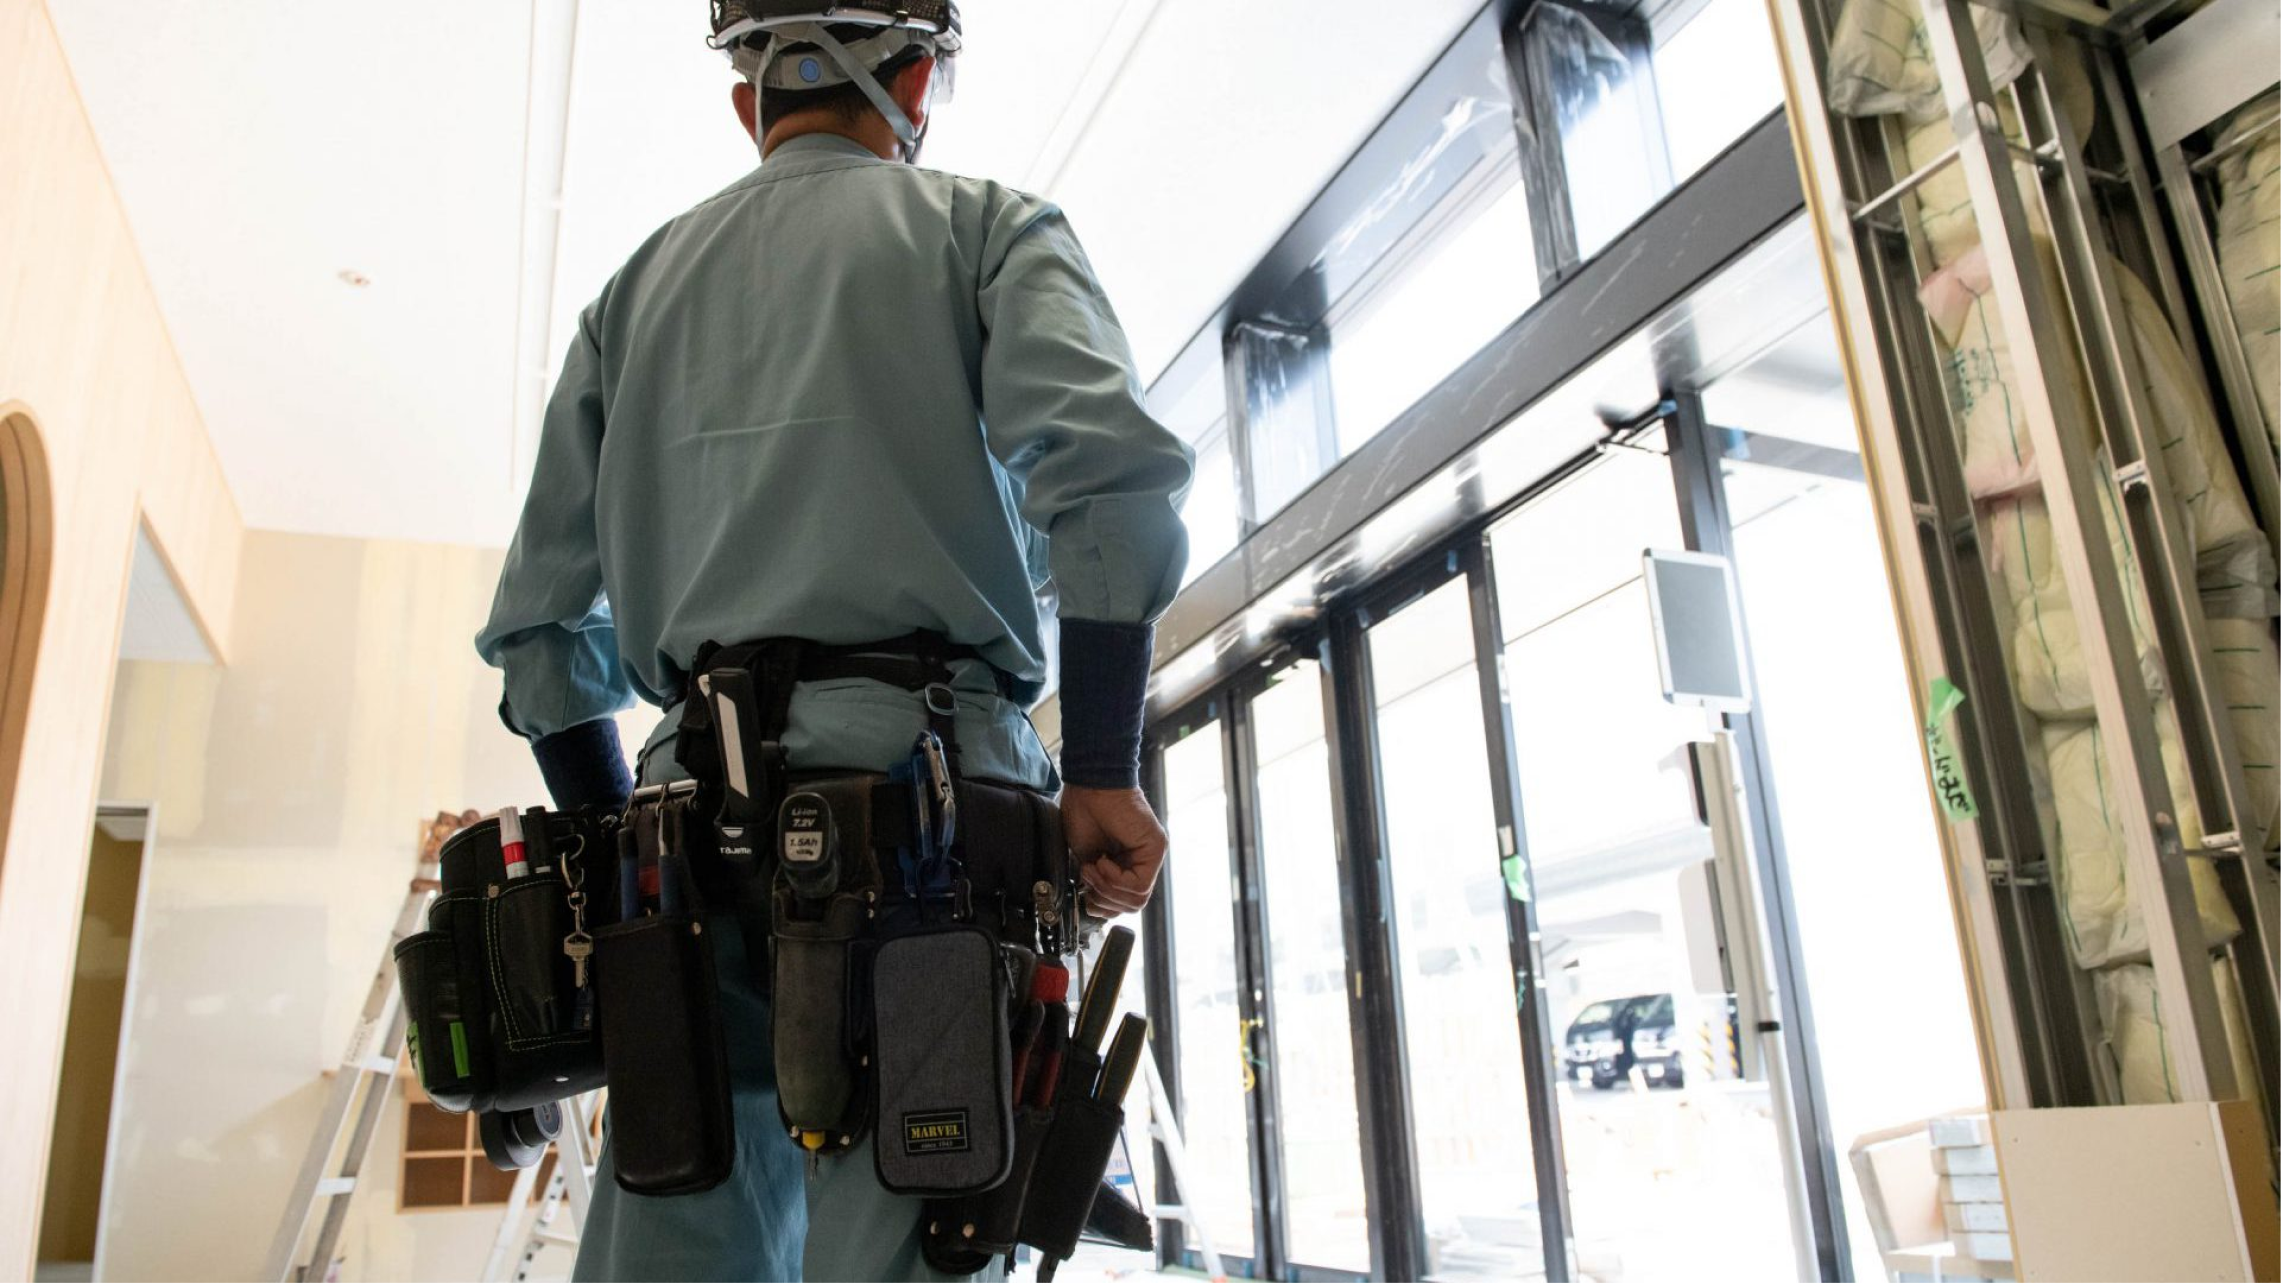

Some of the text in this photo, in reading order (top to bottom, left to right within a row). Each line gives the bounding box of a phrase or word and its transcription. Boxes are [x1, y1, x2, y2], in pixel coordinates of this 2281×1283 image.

[793, 818, 815, 827] 7.2V
[790, 838, 817, 846] 1.5Ah
[911, 1125, 960, 1139] MARVEL
